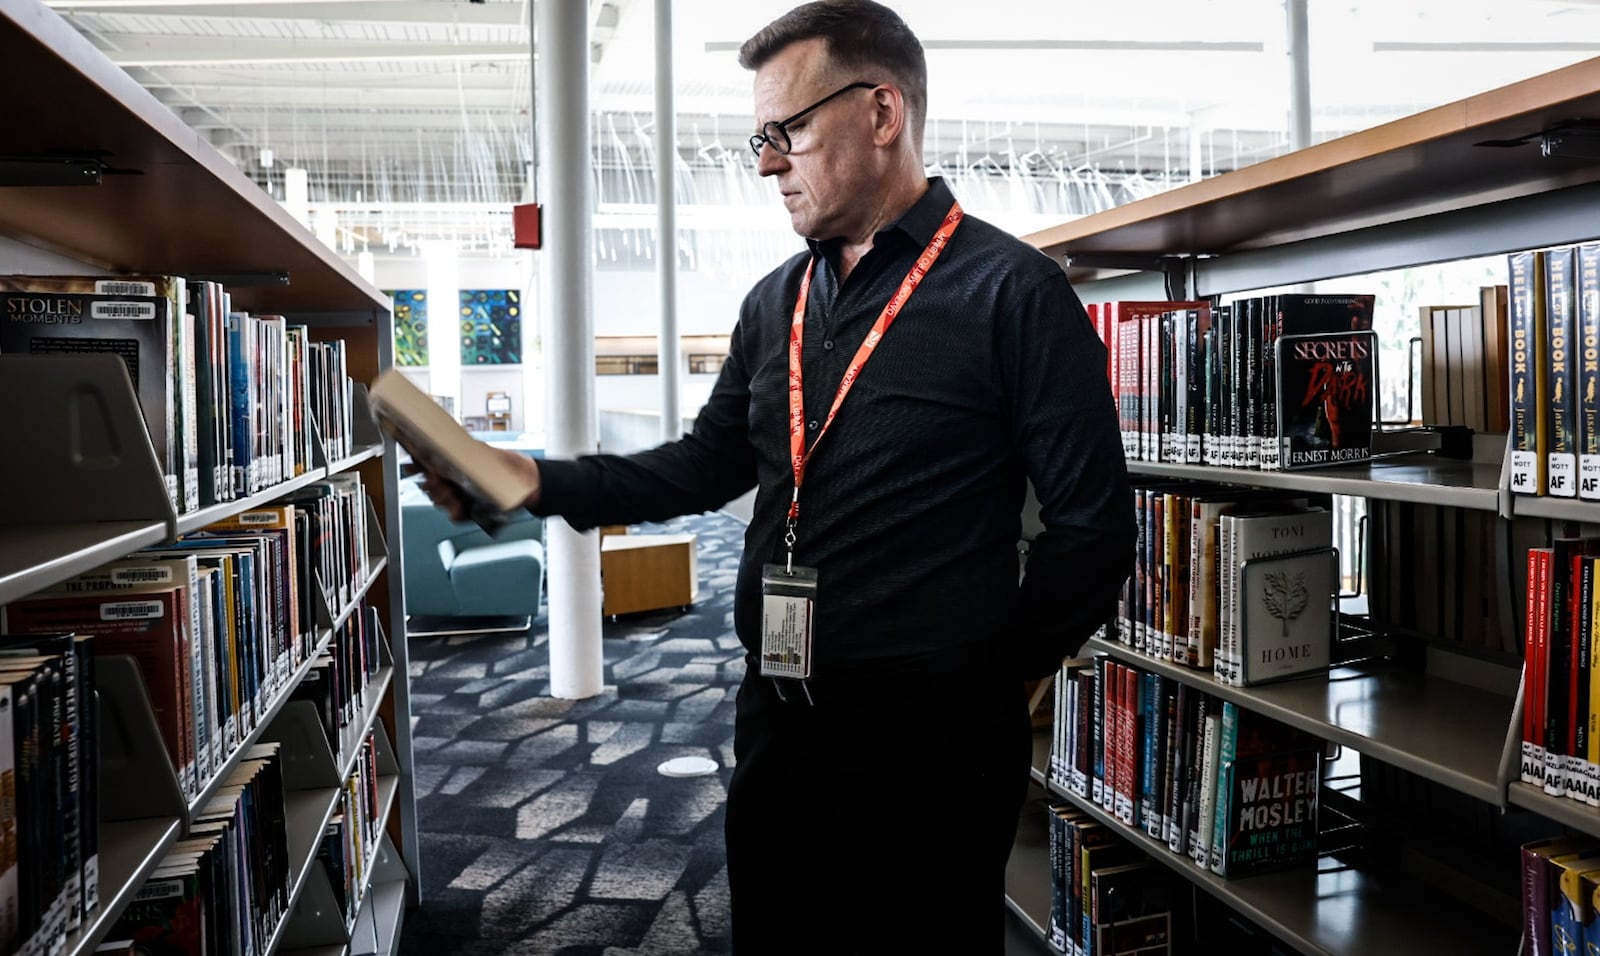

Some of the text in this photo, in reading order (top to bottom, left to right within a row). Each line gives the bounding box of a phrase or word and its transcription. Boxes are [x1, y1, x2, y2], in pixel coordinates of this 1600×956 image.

[1513, 263, 1525, 303] HELL
[1552, 260, 1564, 304] HELL
[1583, 256, 1597, 297] HELL
[7, 298, 82, 314] STOLEN
[10, 314, 82, 324] MOMENTS
[1294, 340, 1368, 359] SECRETS
[1514, 329, 1526, 374] BOOK
[1552, 328, 1564, 373] BOOK
[1584, 325, 1597, 372] BOOK
[1301, 362, 1368, 411] DARK
[792, 404, 800, 436] LIBRARY
[1516, 407, 1526, 437] Jason
[1553, 408, 1564, 438] Jason
[1586, 408, 1597, 439] Jason
[1292, 447, 1369, 463] ERNEST MORRIS
[1514, 473, 1527, 486] AF
[1551, 476, 1565, 488] AF
[1582, 478, 1598, 491] AF
[1272, 525, 1304, 538] TONI
[66, 582, 82, 592] THE
[191, 593, 202, 659] PROPHETS
[63, 650, 75, 684] ZORA
[1176, 651, 1183, 659] AF
[1261, 643, 1312, 663] HOME
[1125, 712, 1133, 759] CHERISH
[66, 732, 78, 792] HURSTON
[1240, 770, 1316, 804] WALTER
[1546, 774, 1560, 787] AF
[1239, 798, 1316, 832] MOSLEY
[1249, 825, 1304, 846] WHEN THE
[1231, 847, 1272, 863] THRILL
